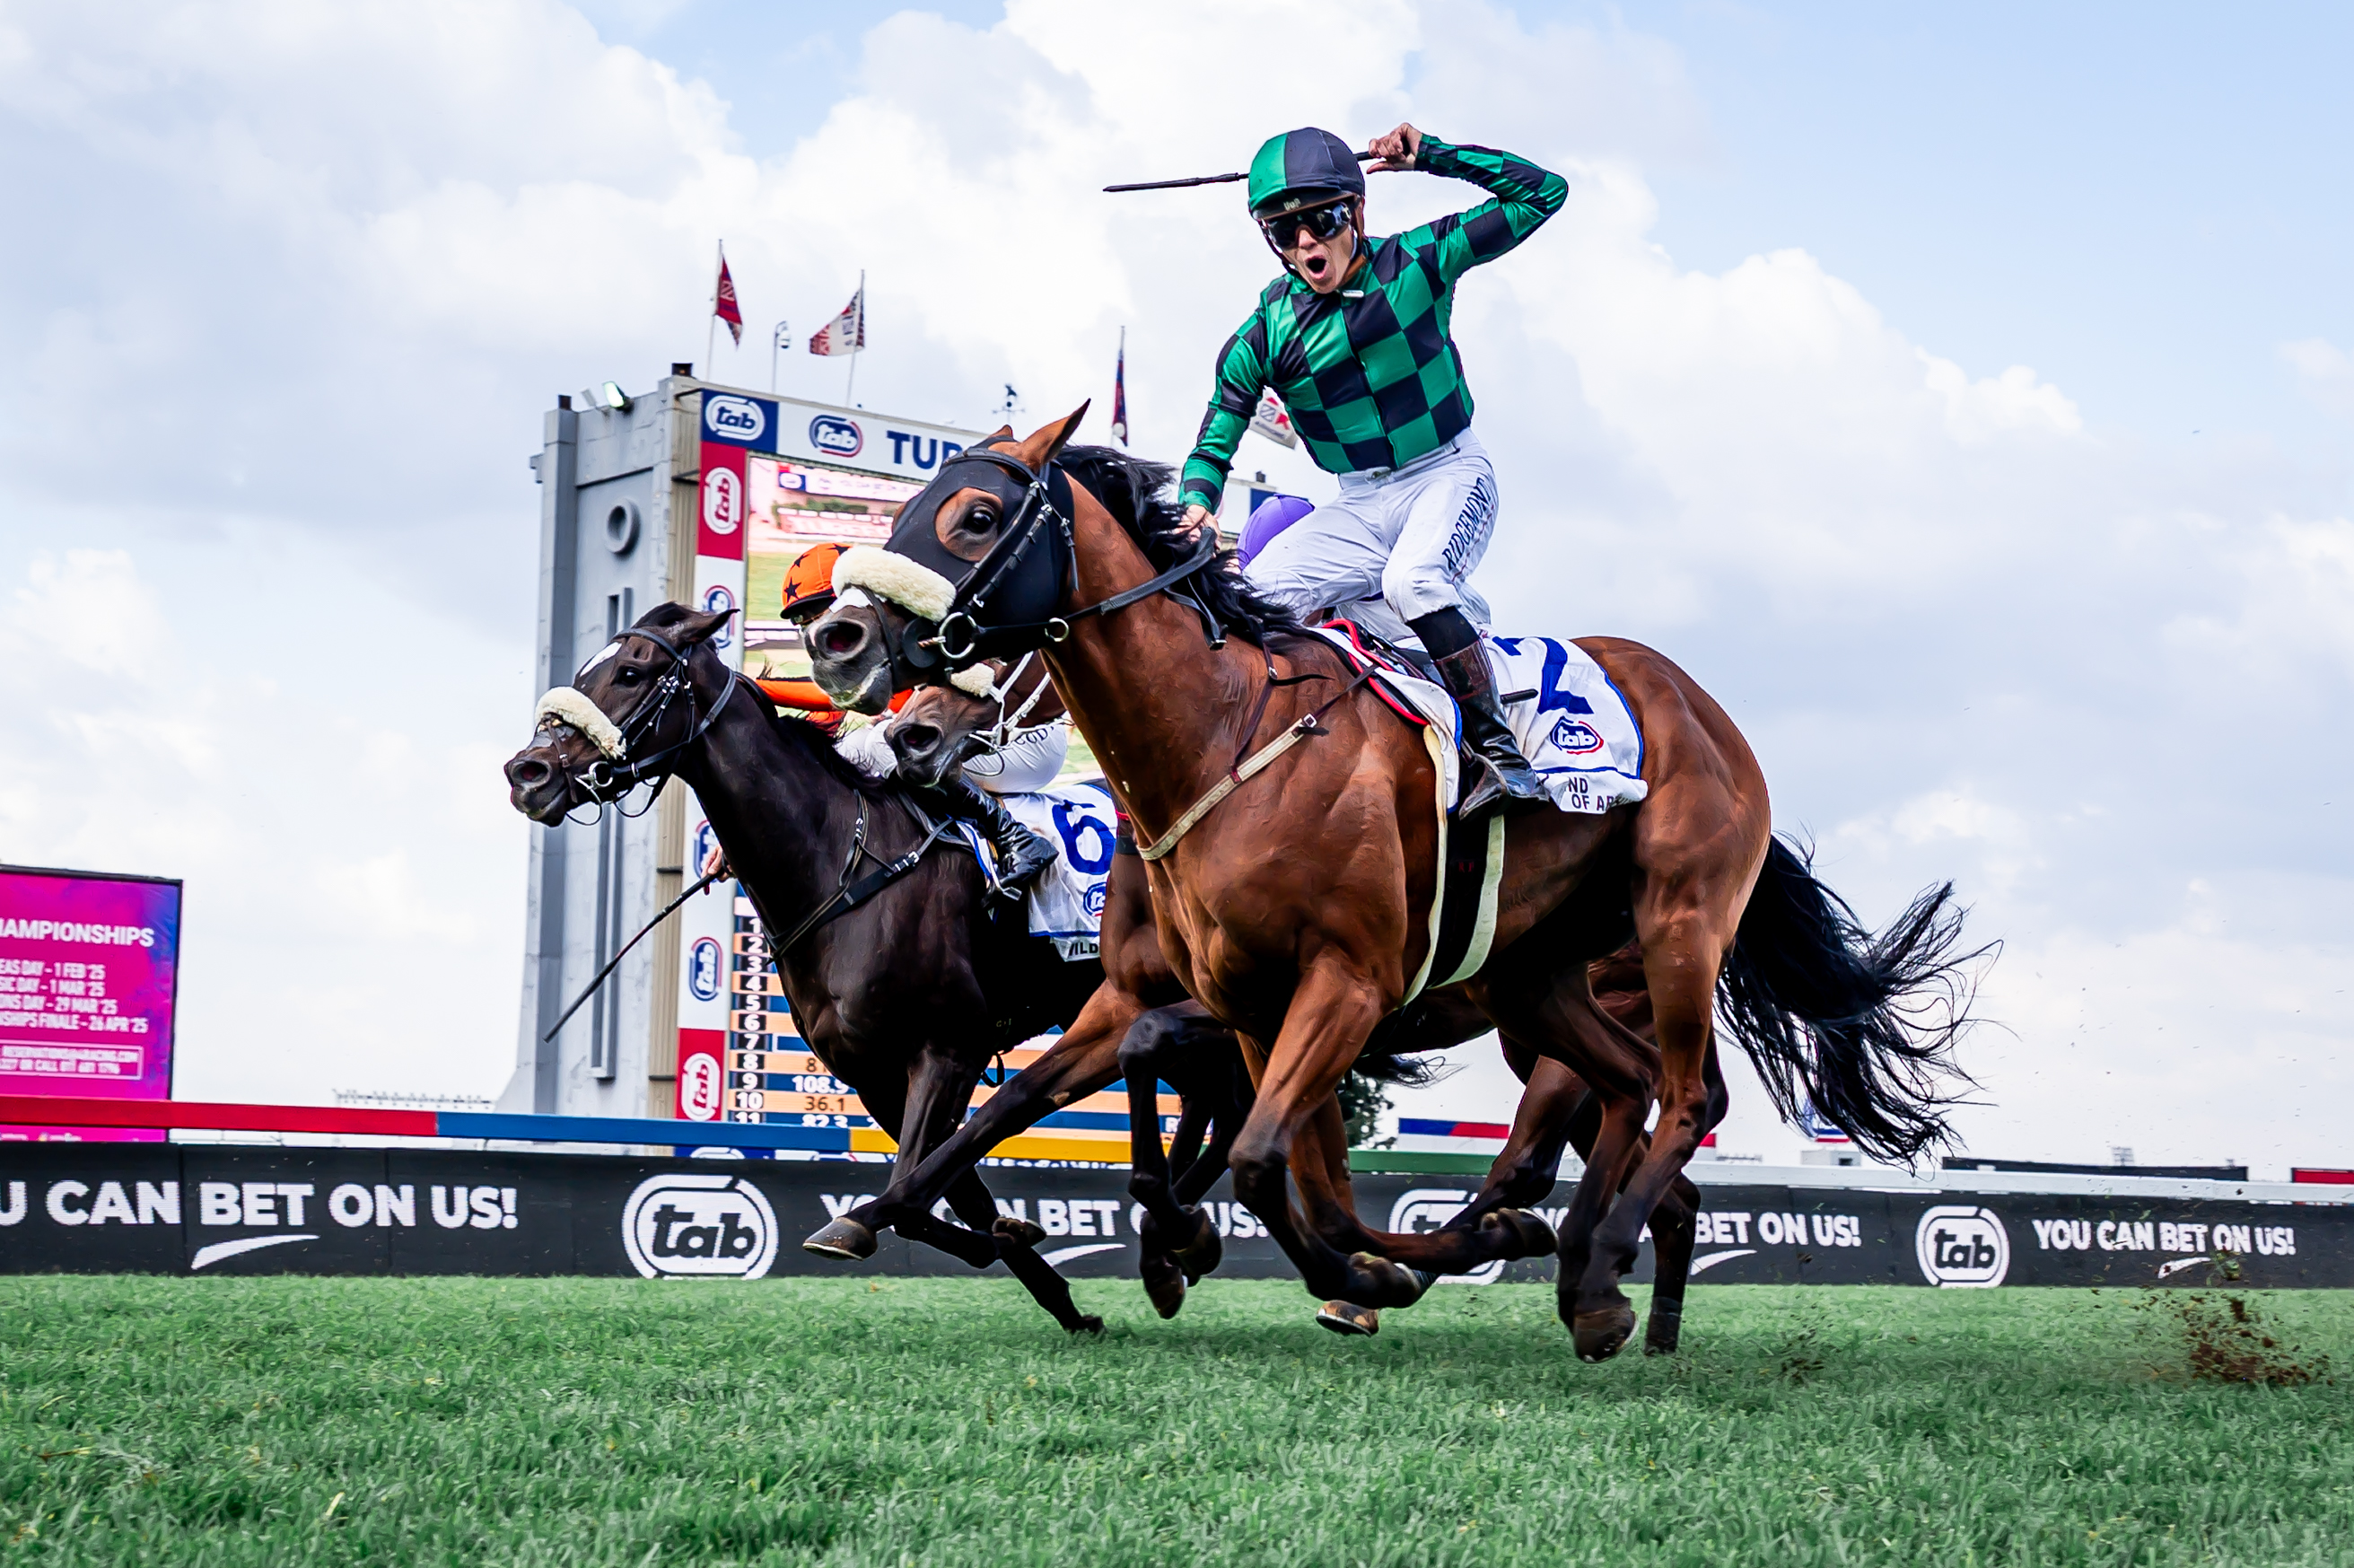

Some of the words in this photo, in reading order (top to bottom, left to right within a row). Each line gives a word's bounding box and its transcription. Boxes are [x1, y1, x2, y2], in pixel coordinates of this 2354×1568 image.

[715, 406, 757, 430] tab
[818, 423, 859, 451] tab
[713, 477, 731, 523] tab
[1441, 477, 1491, 572] RIDGEMONT
[1557, 725, 1597, 747] tab
[1571, 793, 1590, 810] OF
[1051, 799, 1116, 876] 6
[748, 918, 762, 934] 1
[748, 937, 763, 954] 2
[696, 942, 716, 994] tab
[748, 956, 762, 973] 3
[745, 976, 762, 992] 4
[745, 994, 760, 1012] 5
[744, 1013, 760, 1031] 6
[744, 1033, 759, 1050] 7
[743, 1052, 758, 1070] 8
[692, 1064, 709, 1109] tab
[742, 1073, 757, 1090] 9
[736, 1091, 763, 1109] 10
[804, 1096, 845, 1112] 36.1
[0, 1179, 28, 1227] U
[46, 1179, 181, 1226] CAN
[199, 1181, 315, 1227] BET
[328, 1183, 416, 1229] ON
[430, 1185, 519, 1231] US!
[1037, 1198, 1121, 1237] BET
[652, 1204, 757, 1258] tab
[1694, 1212, 1752, 1244] BET
[1757, 1212, 1809, 1246] ON
[1811, 1214, 1862, 1248] US!
[2032, 1219, 2092, 1250] YOU
[2096, 1220, 2156, 1251] CAN
[2158, 1222, 2209, 1253] BET
[2212, 1223, 2253, 1254] ON
[2253, 1226, 2297, 1256] US!
[1933, 1228, 1996, 1269] tab
